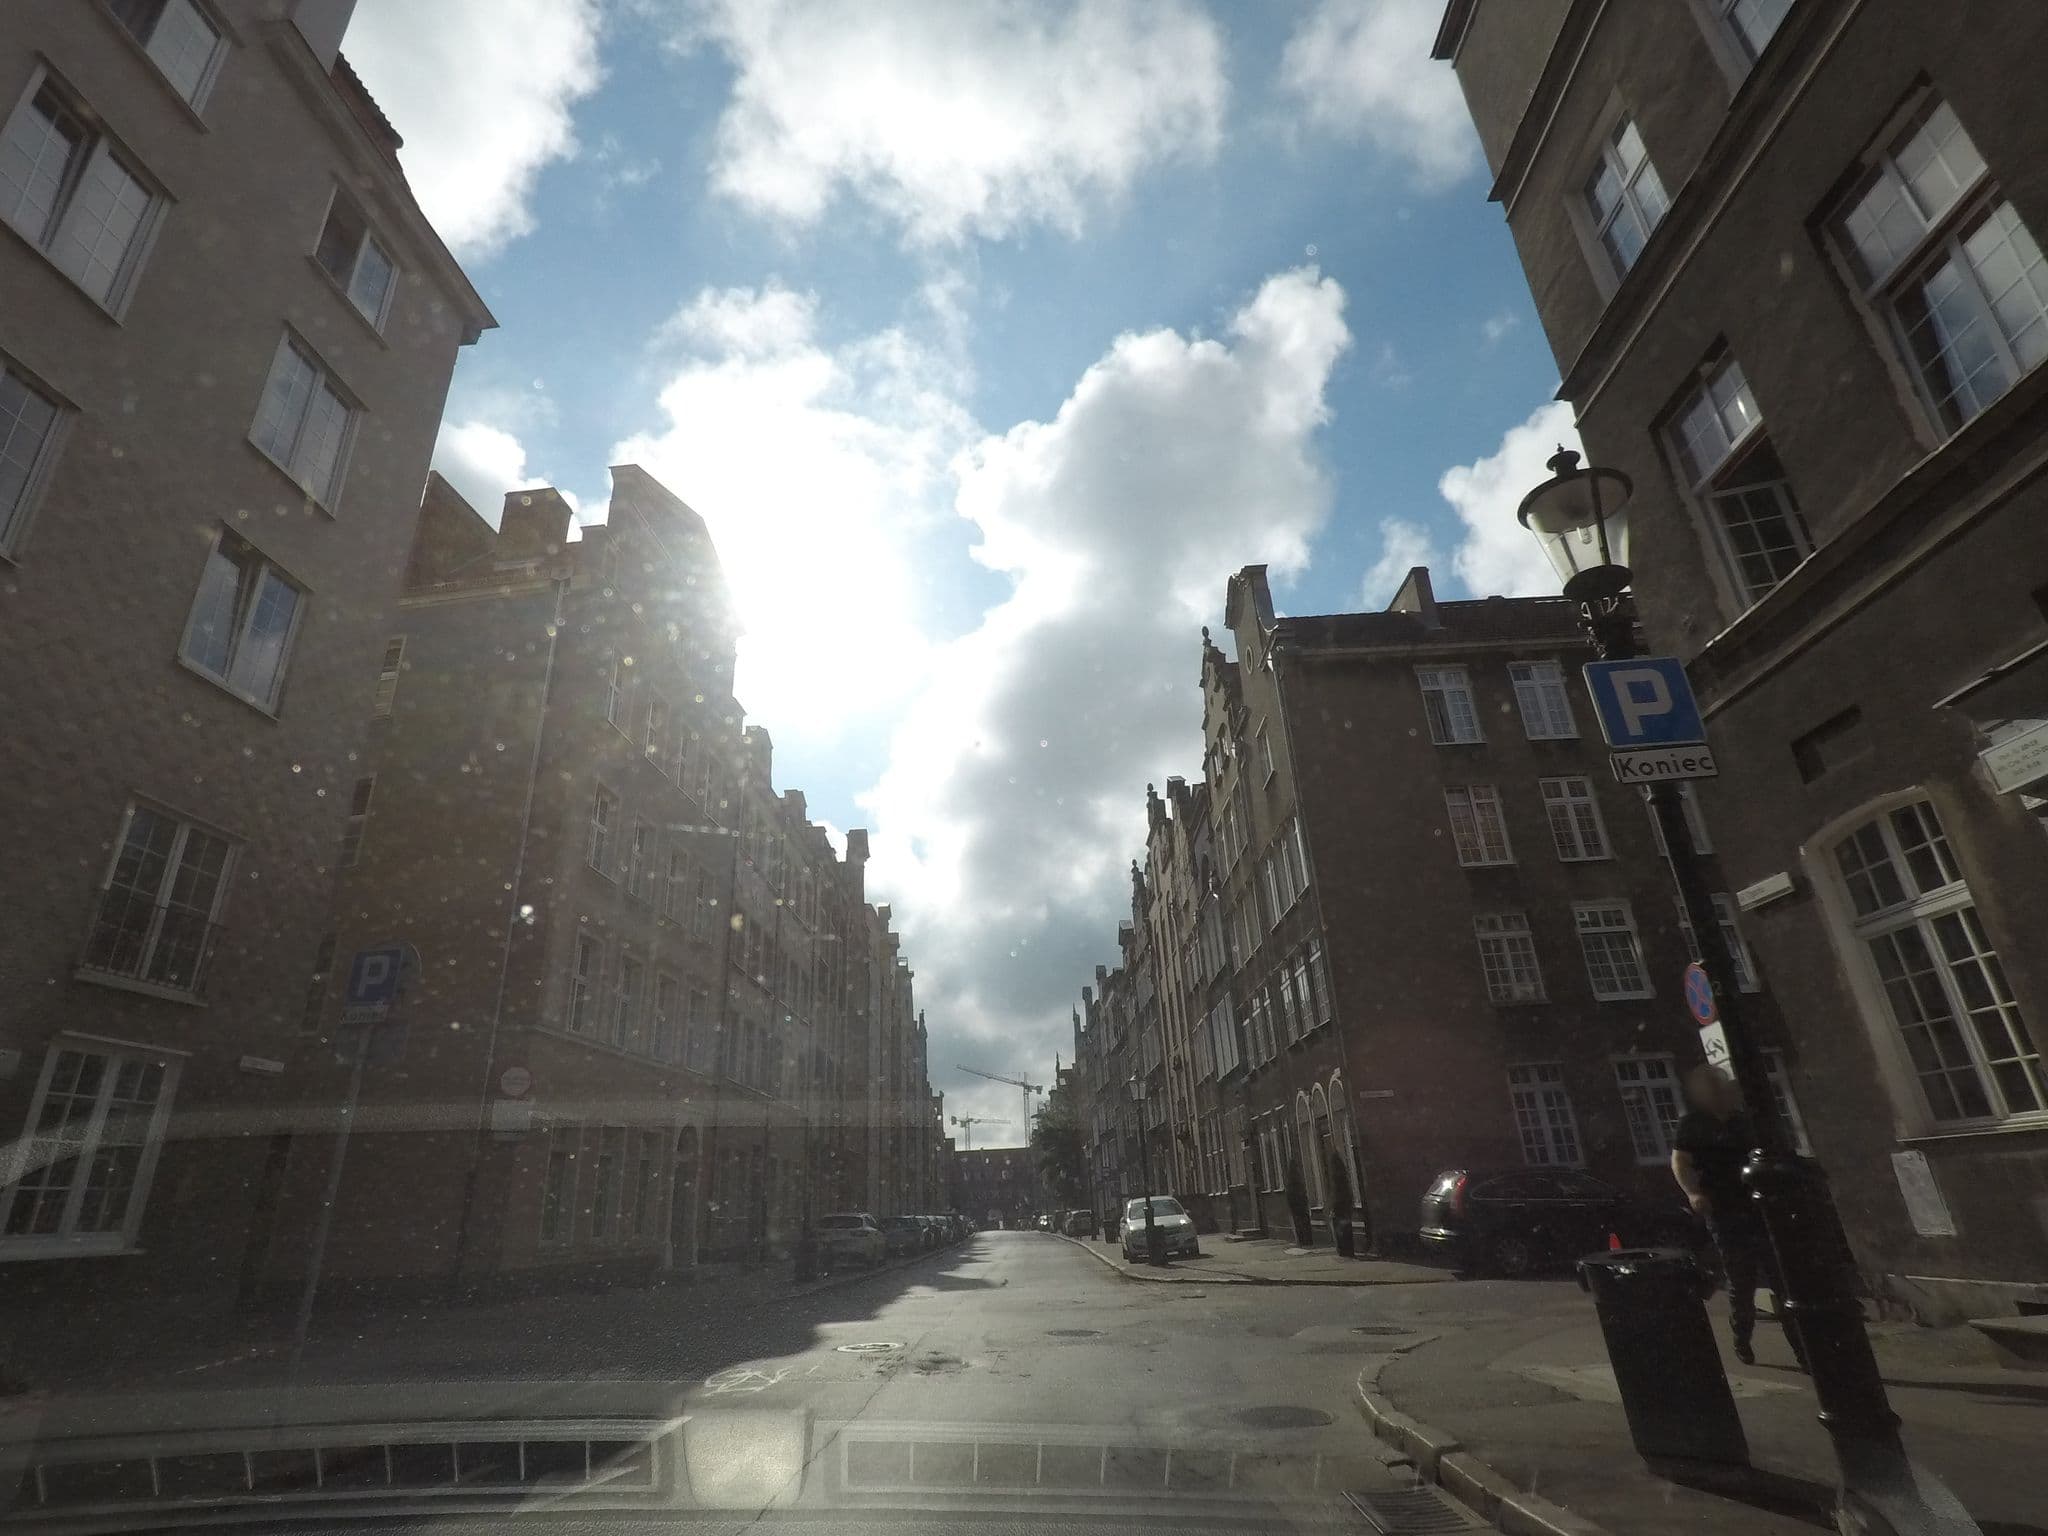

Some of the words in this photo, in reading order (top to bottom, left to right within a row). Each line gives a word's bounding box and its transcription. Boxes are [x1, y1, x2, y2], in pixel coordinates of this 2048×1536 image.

[1609, 669, 1673, 736] P
[1618, 753, 1713, 778] Koniec
[357, 954, 391, 998] P
